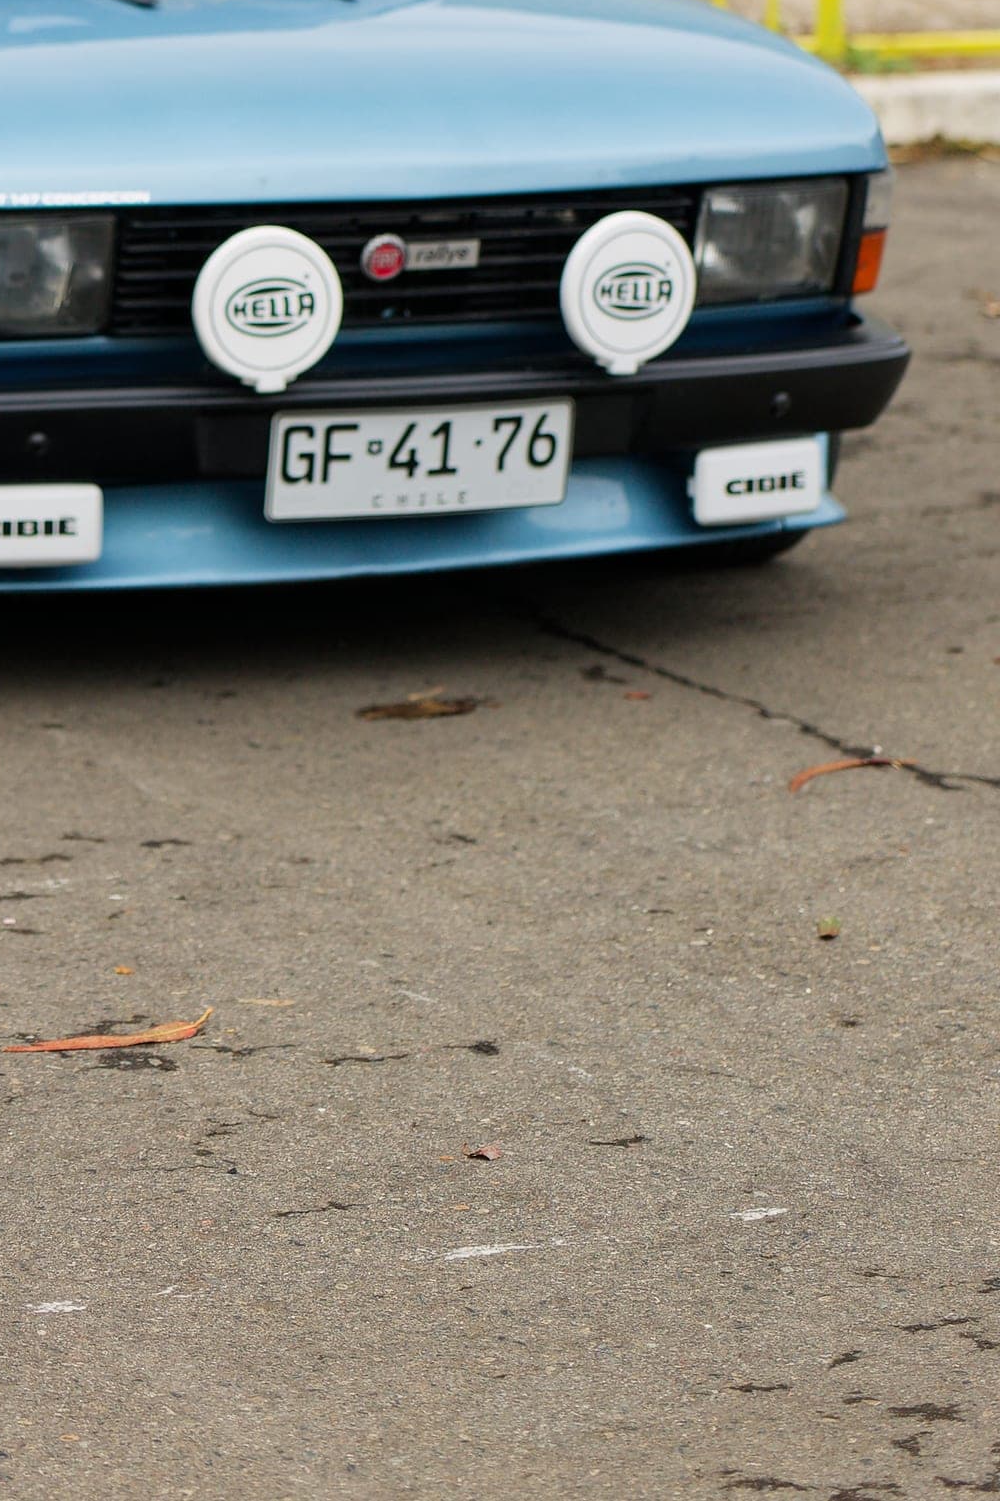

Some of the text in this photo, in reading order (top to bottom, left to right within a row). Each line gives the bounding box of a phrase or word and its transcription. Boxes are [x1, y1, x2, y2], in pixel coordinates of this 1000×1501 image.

[601, 279, 673, 302] HELLA
[234, 290, 315, 318] HELLA
[371, 491, 468, 509] CHILE
